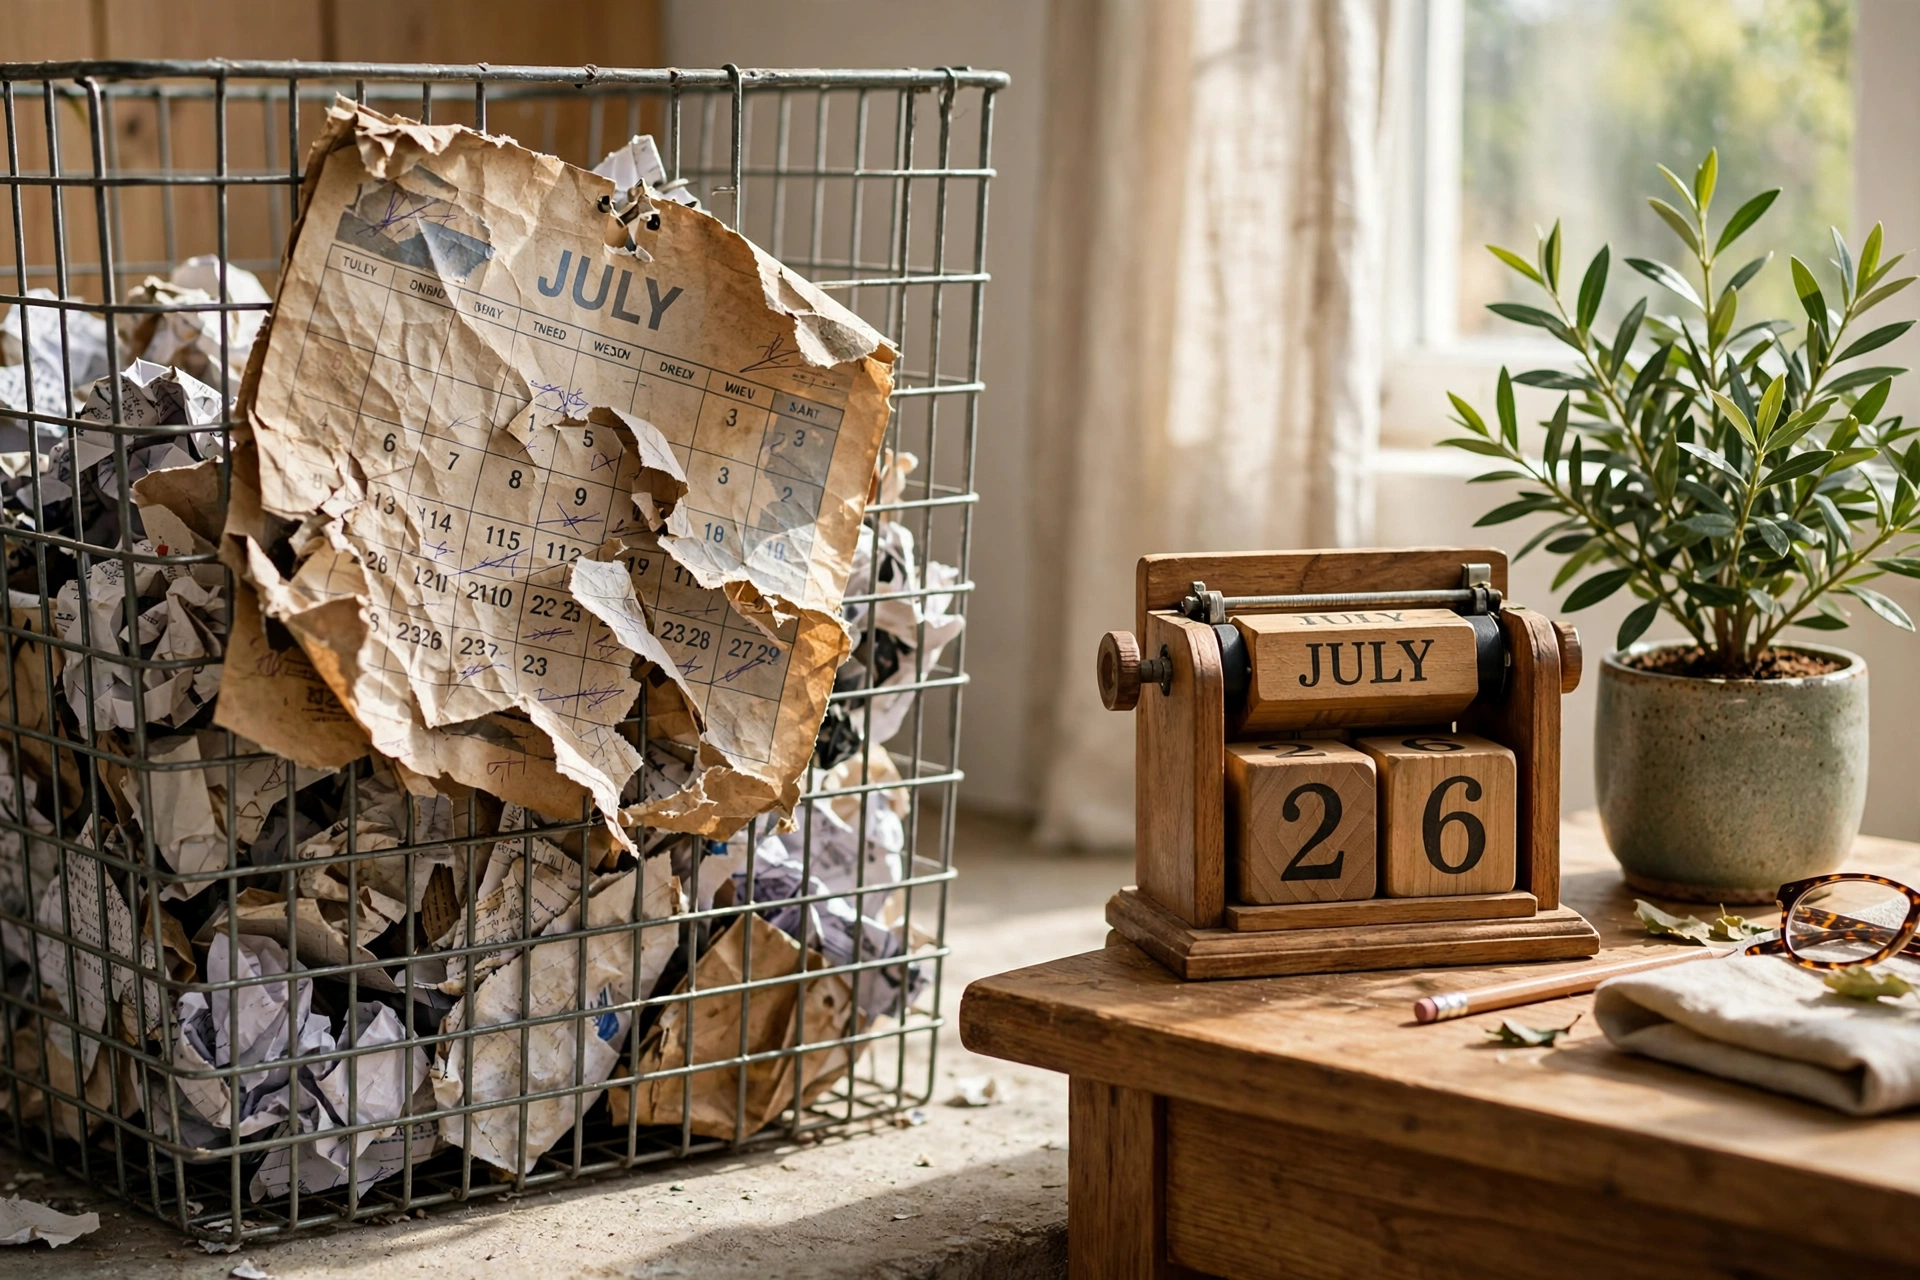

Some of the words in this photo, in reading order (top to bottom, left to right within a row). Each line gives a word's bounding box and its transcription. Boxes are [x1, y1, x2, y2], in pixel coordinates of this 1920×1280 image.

[537, 250, 684, 331] JULY
[725, 408, 739, 427] 3
[793, 429, 806, 448] 3
[383, 432, 397, 452] 6
[447, 451, 460, 470] 7
[508, 470, 523, 489] 8
[573, 487, 588, 506] 9
[704, 522, 725, 543] 18
[582, 429, 594, 448] 5
[717, 466, 730, 485] 3
[781, 486, 793, 503] 2
[374, 492, 396, 515] 13
[486, 525, 521, 550] 115
[1292, 612, 1403, 626] JULY
[522, 654, 548, 676] 23
[1298, 639, 1434, 687] JULY
[1280, 783, 1345, 881] 2
[1422, 775, 1487, 874] 6
